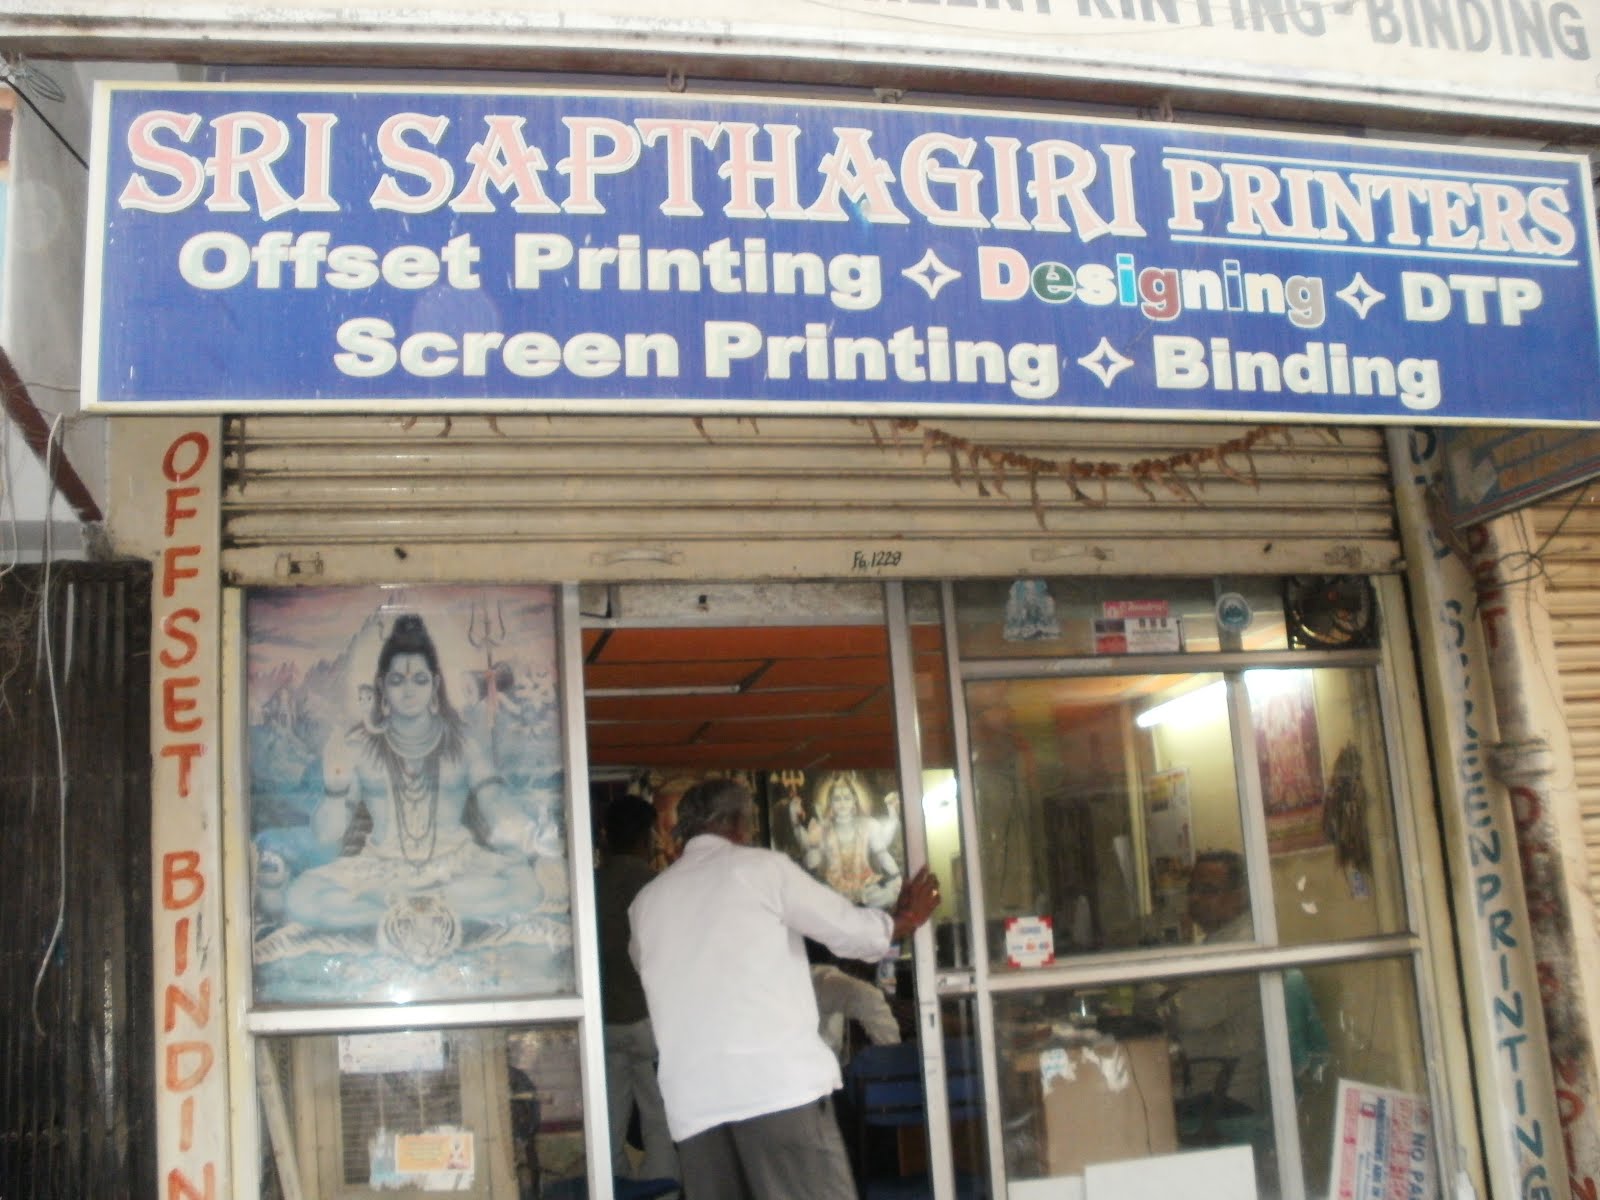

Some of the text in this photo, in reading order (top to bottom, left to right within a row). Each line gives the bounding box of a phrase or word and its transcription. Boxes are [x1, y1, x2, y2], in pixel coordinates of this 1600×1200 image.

[118, 109, 1577, 257] SRI SAPTHAGIRI PRINTERS
[178, 231, 1543, 328] Offset Printing Designing DTP
[333, 316, 1442, 410] Screen Printing Binding
[159, 431, 210, 799] OFFSET
